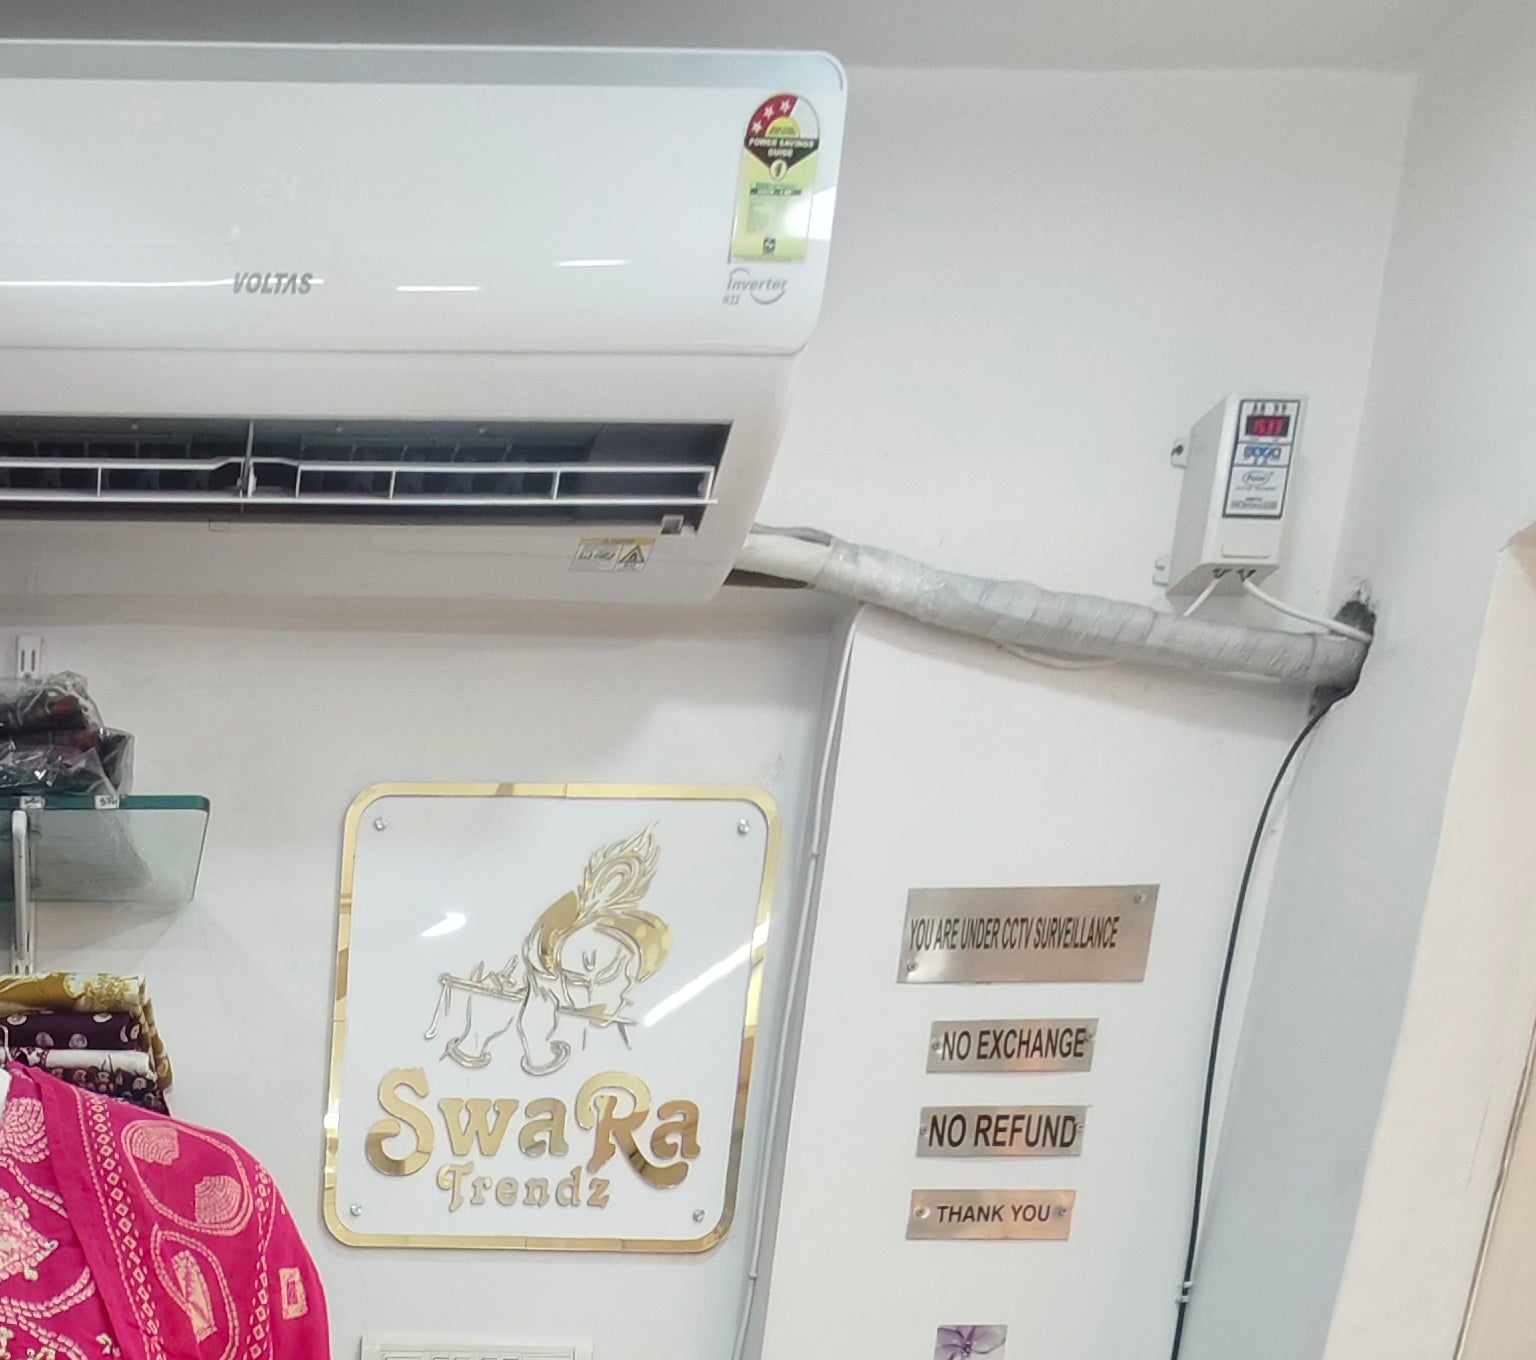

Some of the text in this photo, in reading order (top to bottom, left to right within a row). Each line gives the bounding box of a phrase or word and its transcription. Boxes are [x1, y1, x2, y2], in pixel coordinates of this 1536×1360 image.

[232, 272, 313, 295] VOLTAS
[909, 916, 1120, 950] YOU ARE UNDER CCTV SURVEILLANCE
[941, 1028, 1087, 1060] NO EXCHANGE
[367, 1067, 701, 1189] SwaRa
[928, 1114, 1077, 1148] NO REFUND
[436, 1162, 611, 1212] Trendz
[937, 1205, 1051, 1223] THANK YOU
